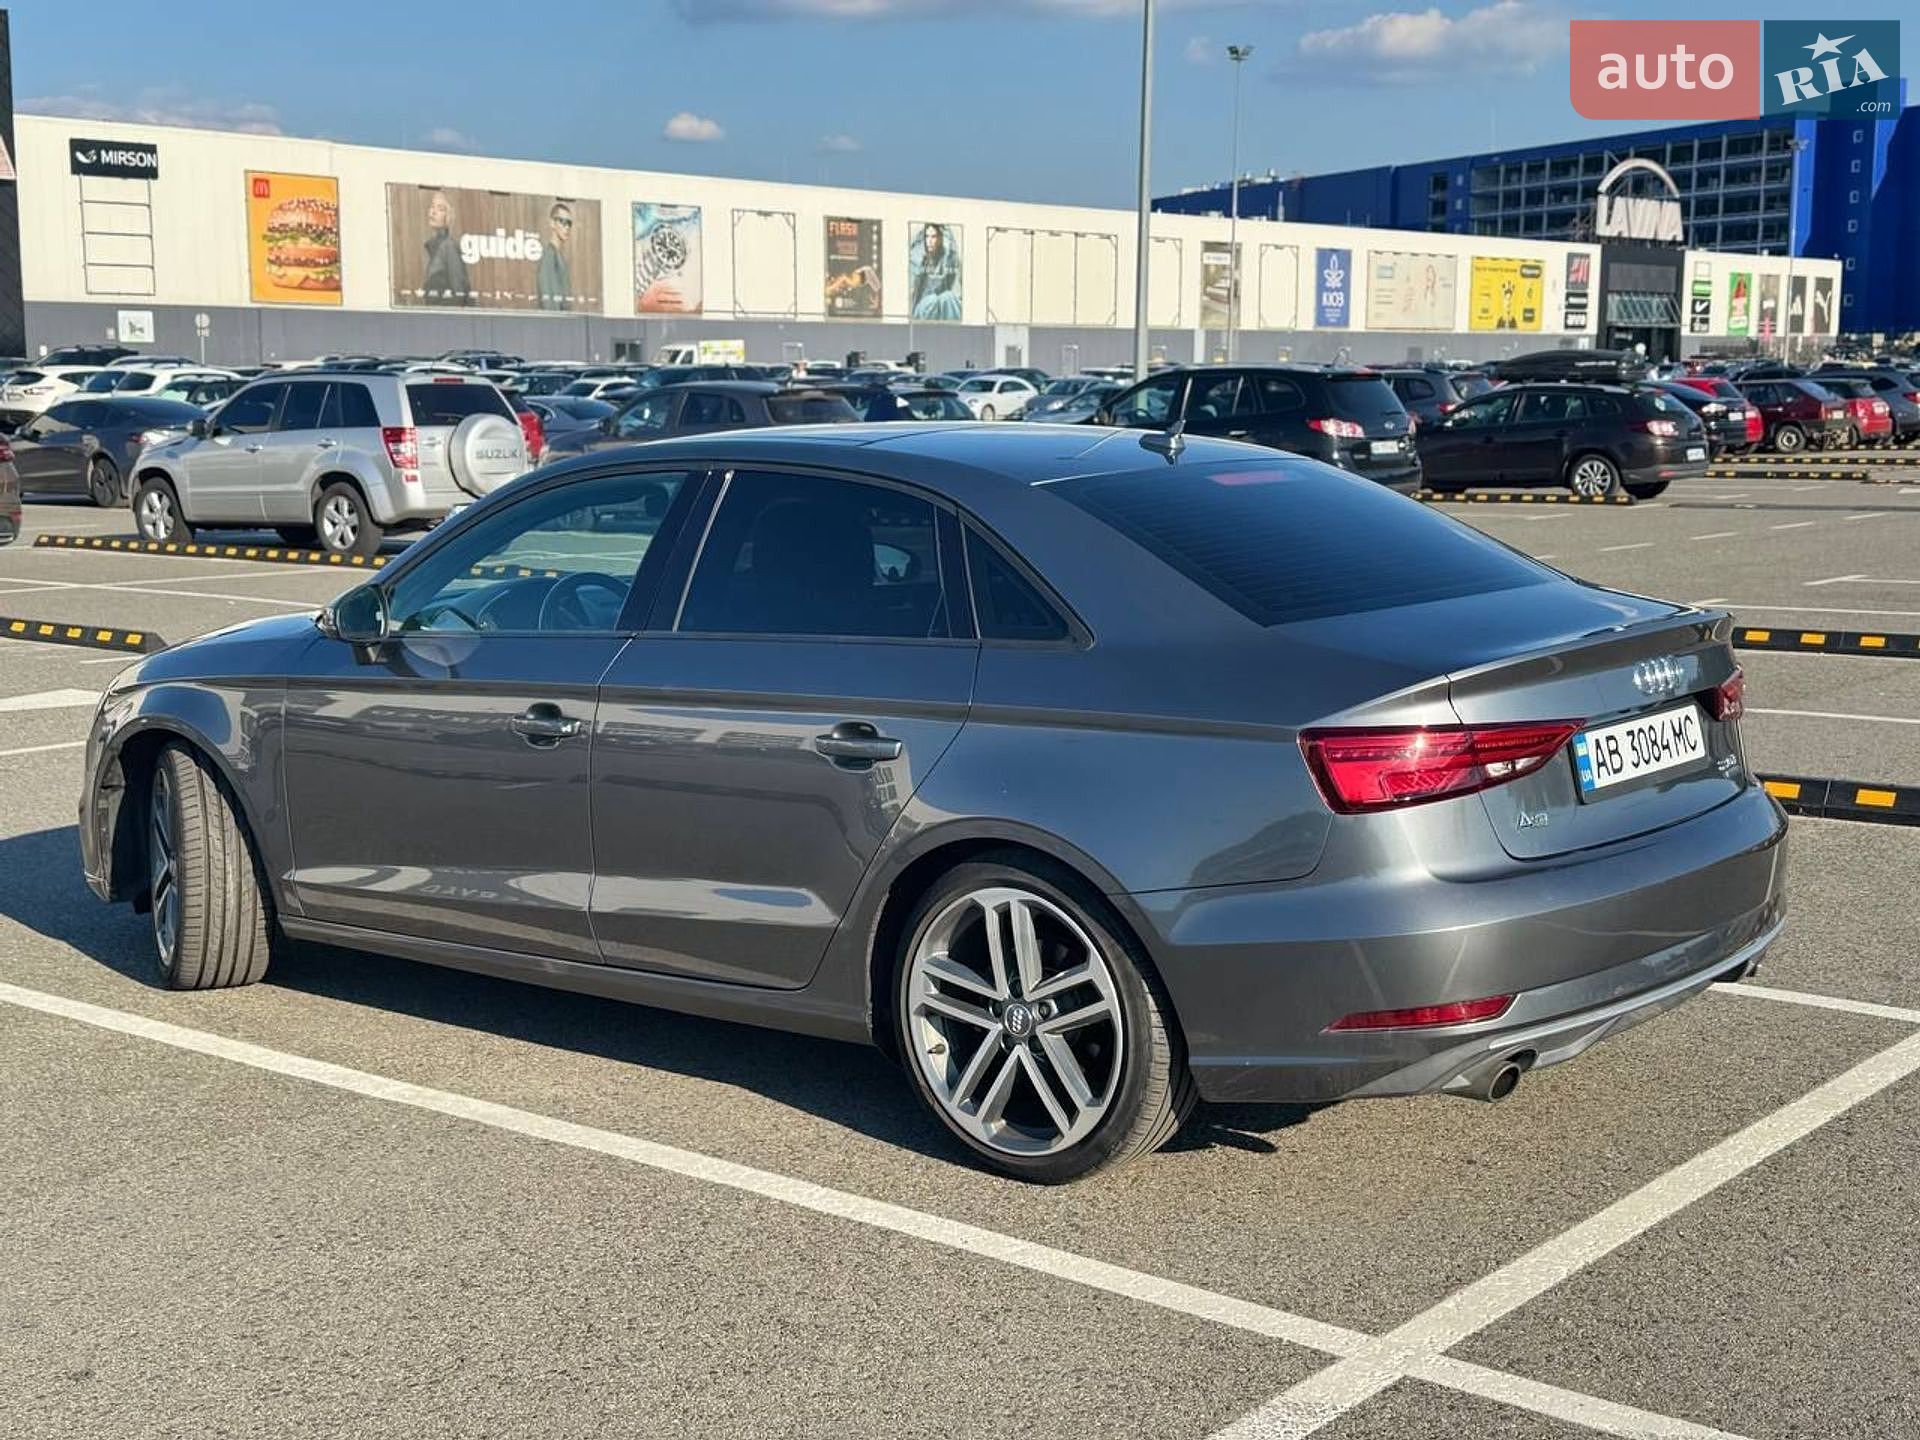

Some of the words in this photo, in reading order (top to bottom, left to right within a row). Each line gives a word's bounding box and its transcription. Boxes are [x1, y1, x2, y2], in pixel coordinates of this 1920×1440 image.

[100, 149, 157, 168] MIRSON
[460, 227, 544, 265] guide
[1594, 734, 1624, 779] AB
[1626, 720, 1674, 769] 3084
[1670, 714, 1698, 758] MC
